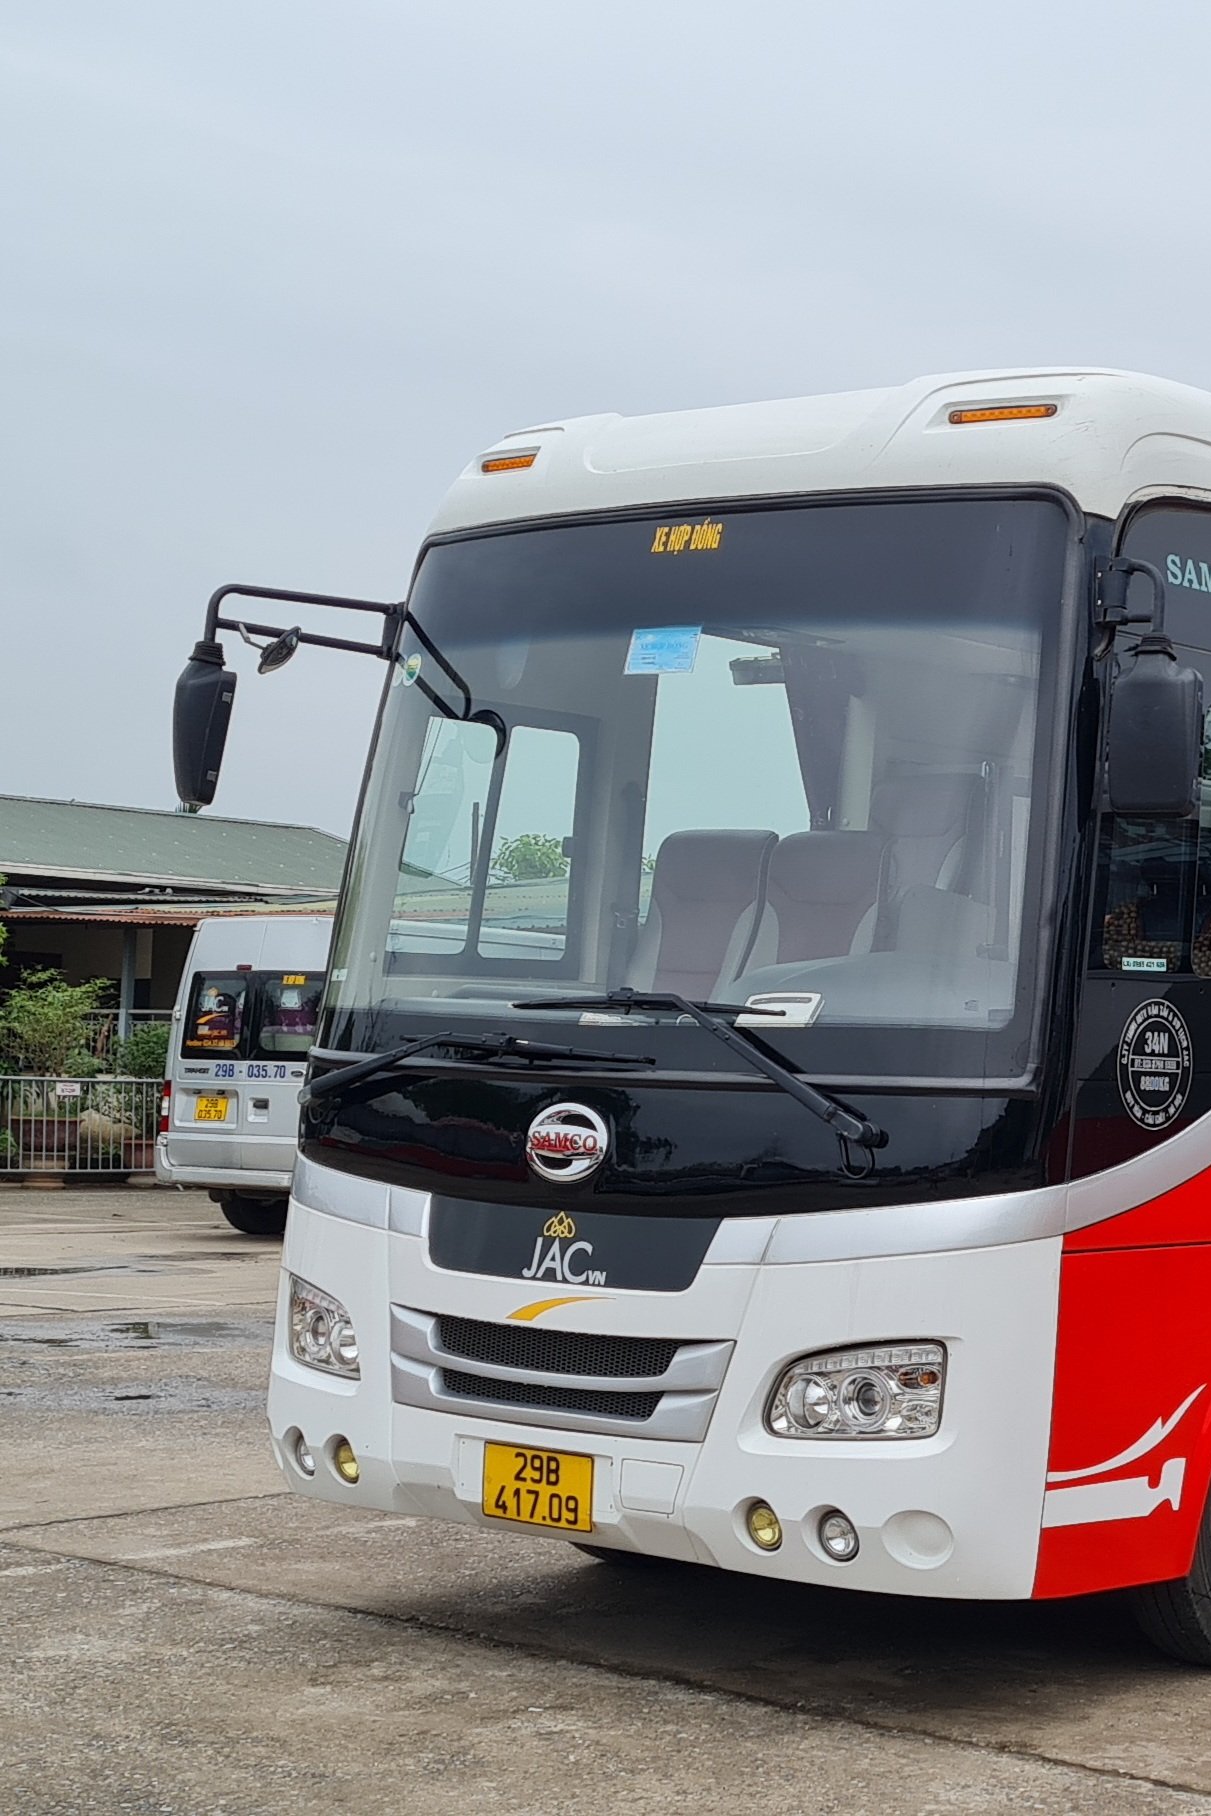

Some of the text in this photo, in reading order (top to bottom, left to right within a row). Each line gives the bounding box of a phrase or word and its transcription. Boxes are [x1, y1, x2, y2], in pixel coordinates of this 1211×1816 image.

[651, 517, 722, 555] XE HỢP ĐỒNG
[1144, 1031, 1169, 1054] 34N
[215, 1064, 235, 1077] 29B
[247, 1065, 286, 1078] 035.70
[531, 1131, 598, 1152] SAMCO
[522, 1237, 593, 1284] JAC
[514, 1452, 561, 1486] 29B
[494, 1485, 579, 1526] 417.09
